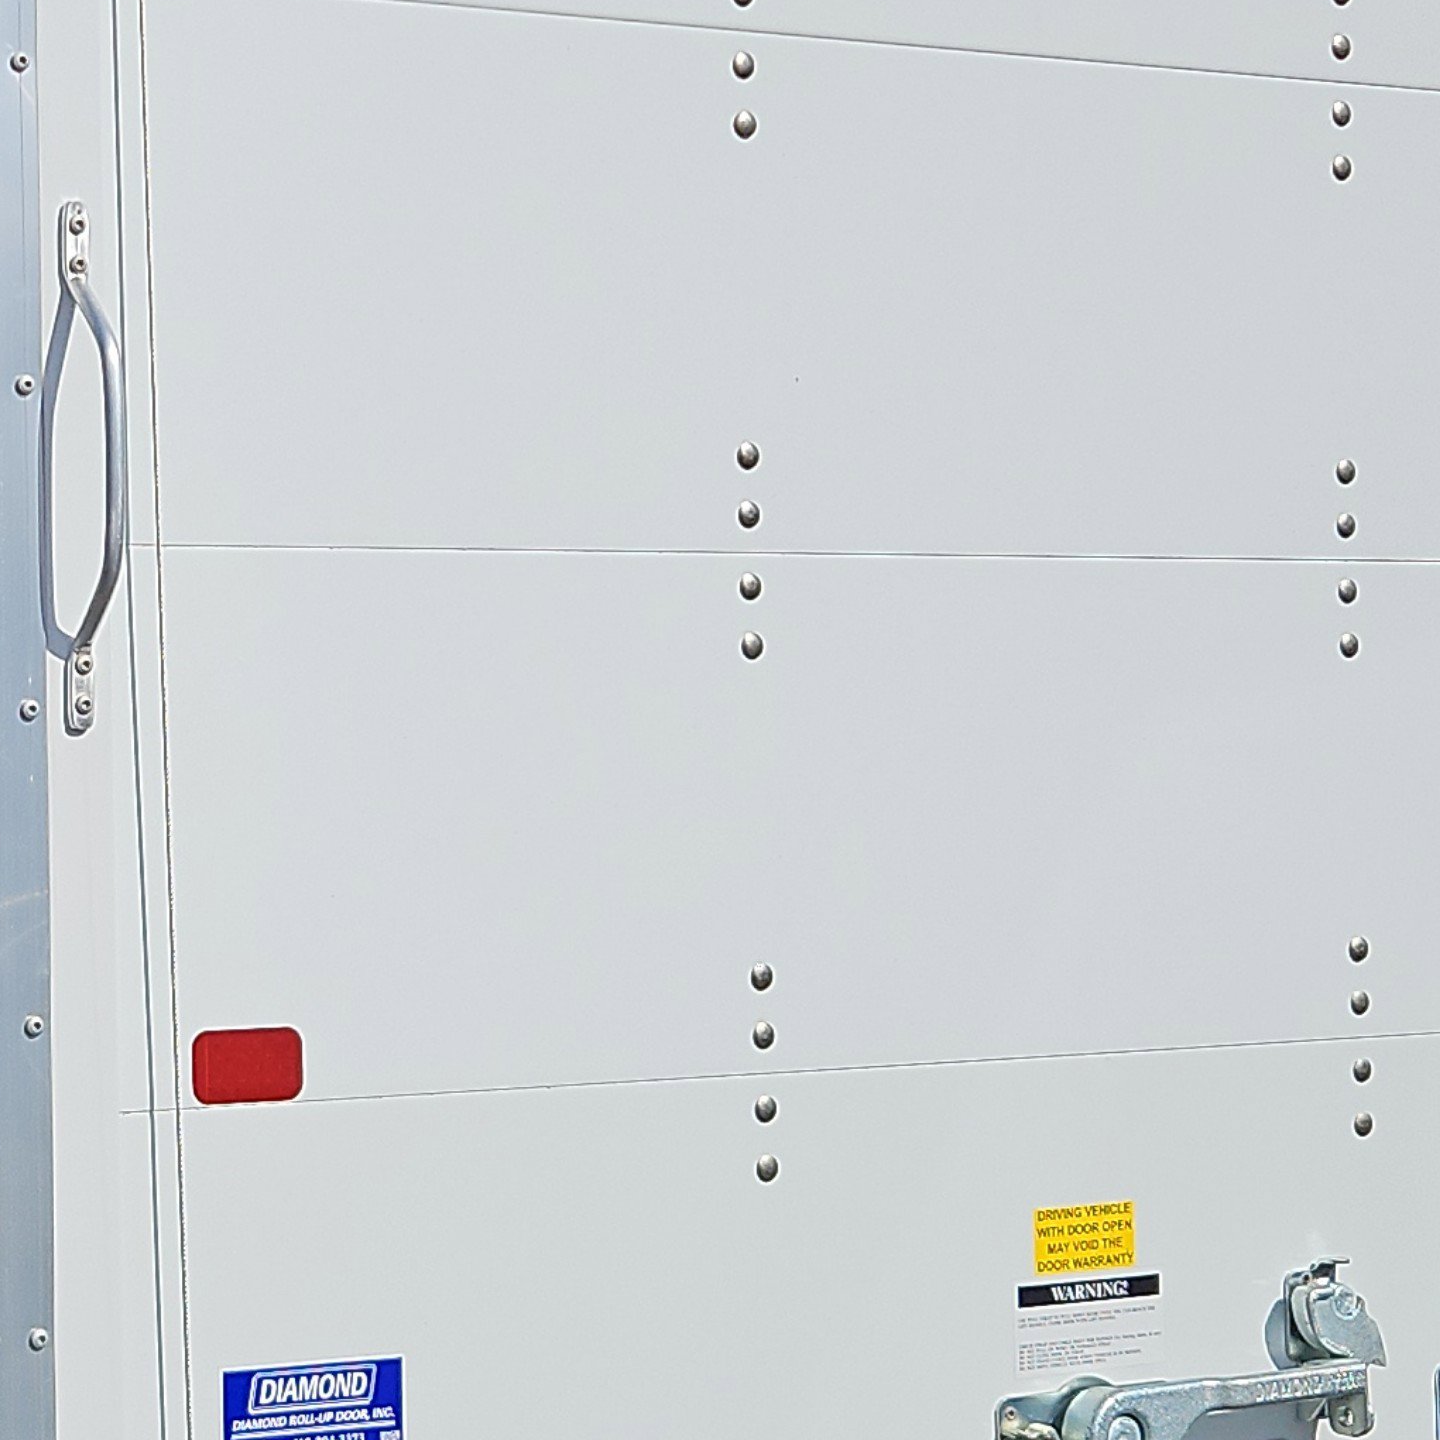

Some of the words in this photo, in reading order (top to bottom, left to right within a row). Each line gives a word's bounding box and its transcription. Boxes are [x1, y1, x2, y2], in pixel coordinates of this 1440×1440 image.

[1038, 1206, 1082, 1222] DRIVING
[1085, 1202, 1132, 1217] VEHICLE
[1037, 1225, 1064, 1238] WITH
[1067, 1222, 1099, 1236] DOOR
[1102, 1219, 1132, 1231] OPEN
[1047, 1242, 1070, 1254] MAY
[1073, 1239, 1099, 1252] VOID
[1103, 1237, 1123, 1249] THE
[1037, 1259, 1070, 1272] DOOR
[1072, 1252, 1134, 1269] WARRANTY
[259, 1371, 368, 1404] DIAMOND
[232, 1416, 287, 1432] DIAMOND
[289, 1412, 334, 1426] ROLL-UP
[372, 1406, 395, 1418] INC.
